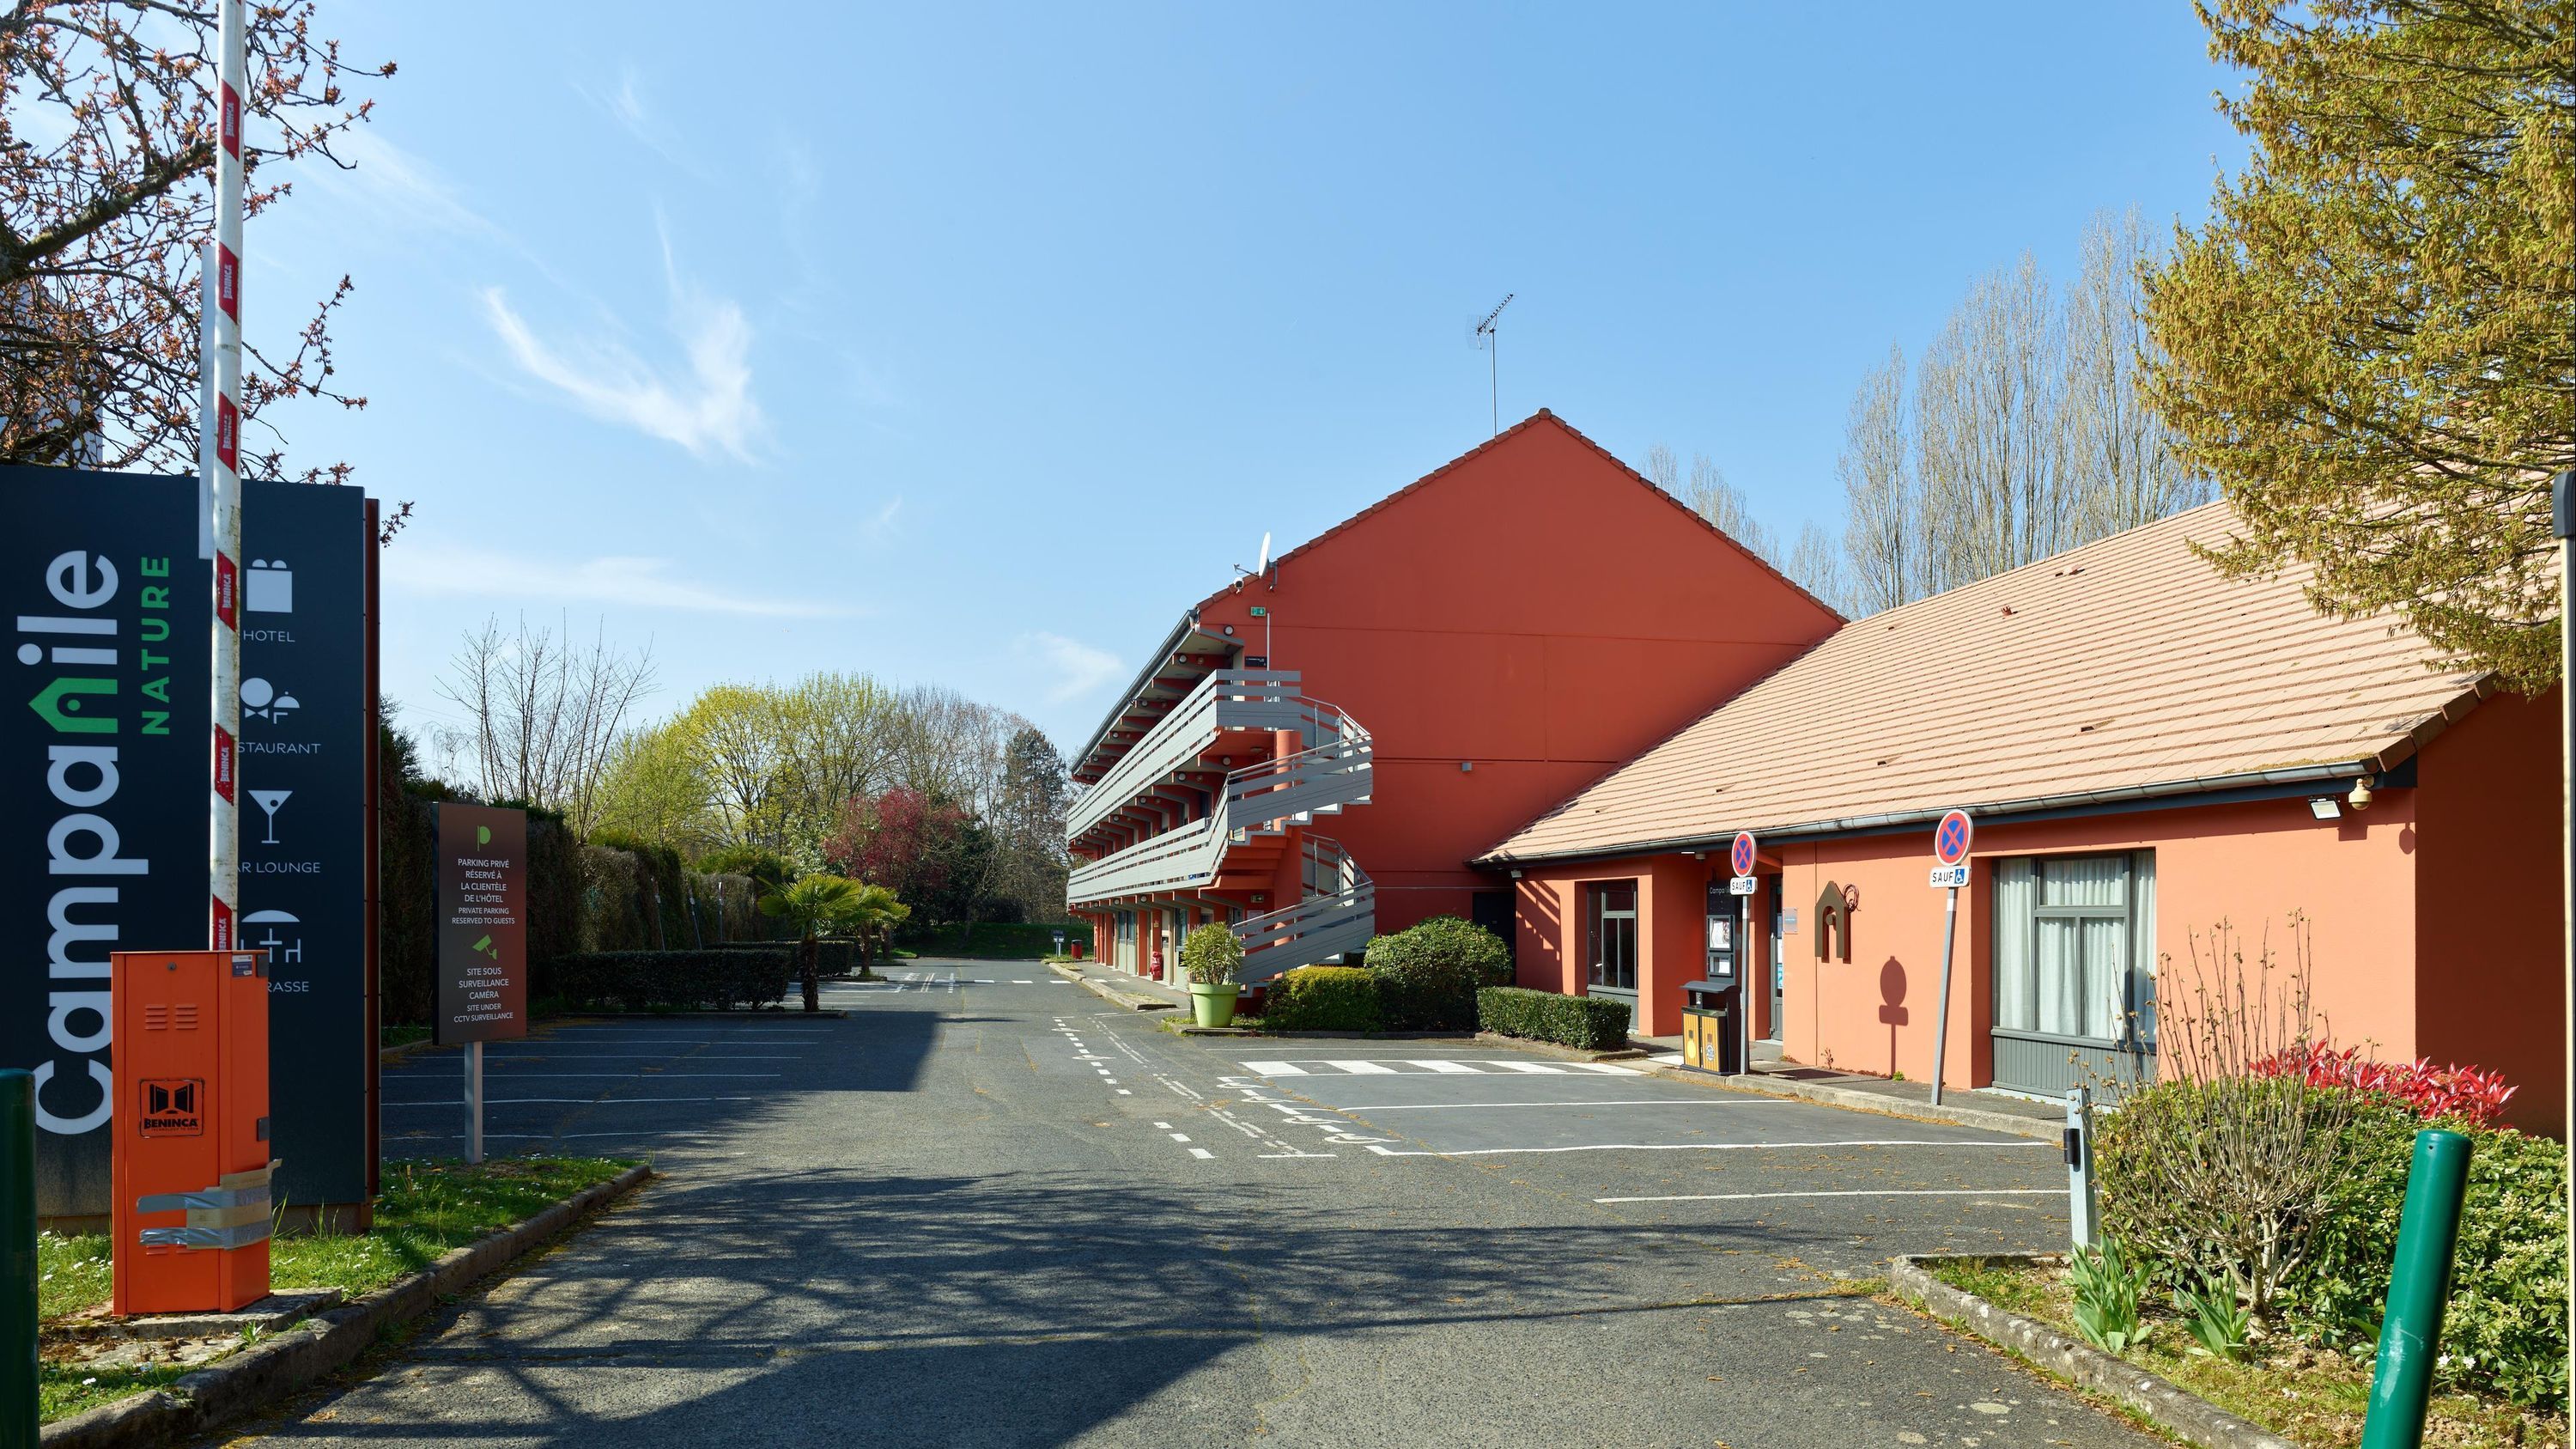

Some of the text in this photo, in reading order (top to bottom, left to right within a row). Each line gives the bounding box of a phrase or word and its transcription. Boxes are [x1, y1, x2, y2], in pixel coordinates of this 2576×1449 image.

[243, 630, 296, 643] HOTEL
[141, 557, 170, 735] NATURE
[238, 741, 322, 755] STAURANT
[17, 550, 149, 1135] Campanile
[256, 861, 321, 874] LOUNGE
[458, 858, 509, 868] PARKING PRIVÉ
[465, 869, 495, 880] RÉSERVÉ
[1933, 871, 1953, 883] SAUF
[460, 881, 507, 892] LA CLIENTÈLE
[1732, 881, 1746, 891] SAUF
[465, 894, 475, 903] DE
[466, 967, 502, 977] SITE SOUS
[459, 978, 509, 989] SURVEILLANCE
[469, 989, 500, 1000] CAMÉRA
[471, 1012, 513, 1022] SURVEILLANCE
